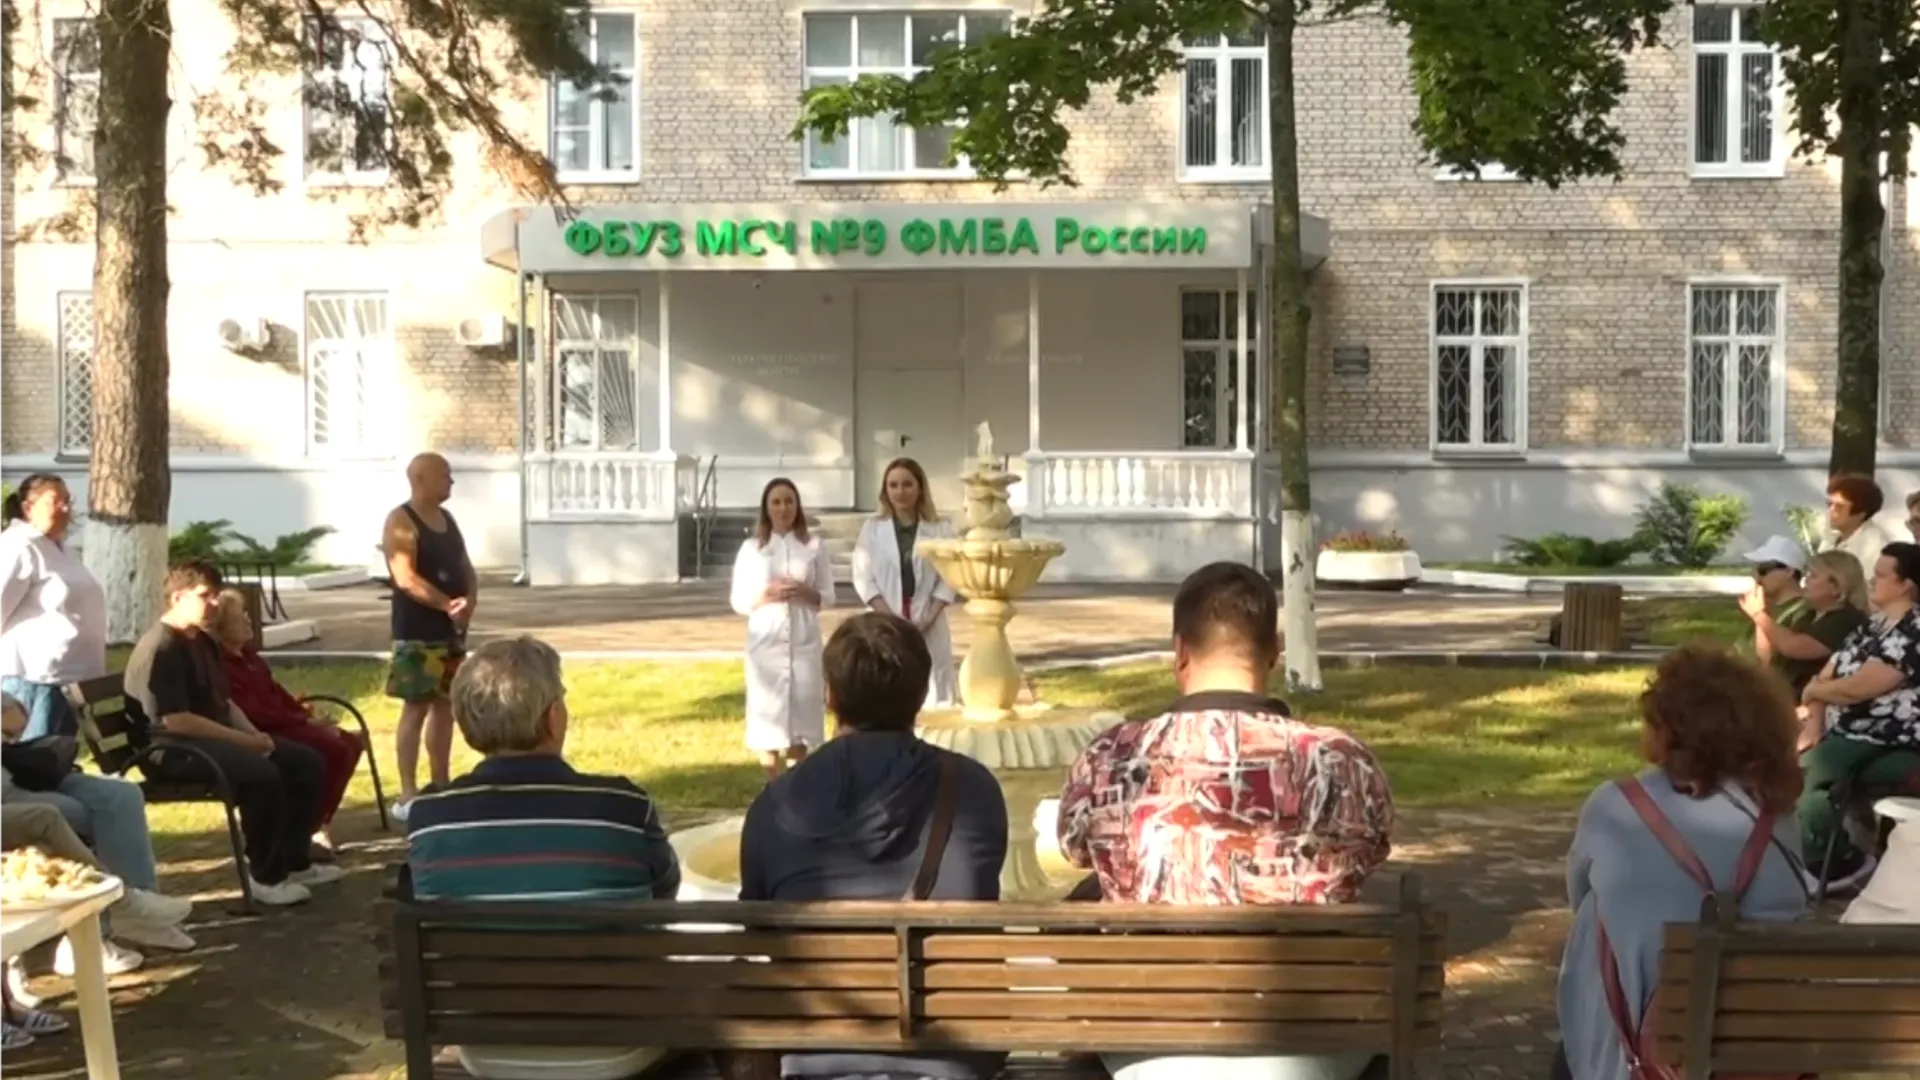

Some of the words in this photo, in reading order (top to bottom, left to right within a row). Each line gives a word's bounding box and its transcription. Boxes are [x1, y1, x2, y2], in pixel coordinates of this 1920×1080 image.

[564, 219, 682, 256] ФБУЗ
[695, 219, 798, 255] МСЧ
[811, 219, 887, 255] №9
[900, 217, 1040, 255] ФМБА
[1055, 217, 1207, 255] России
